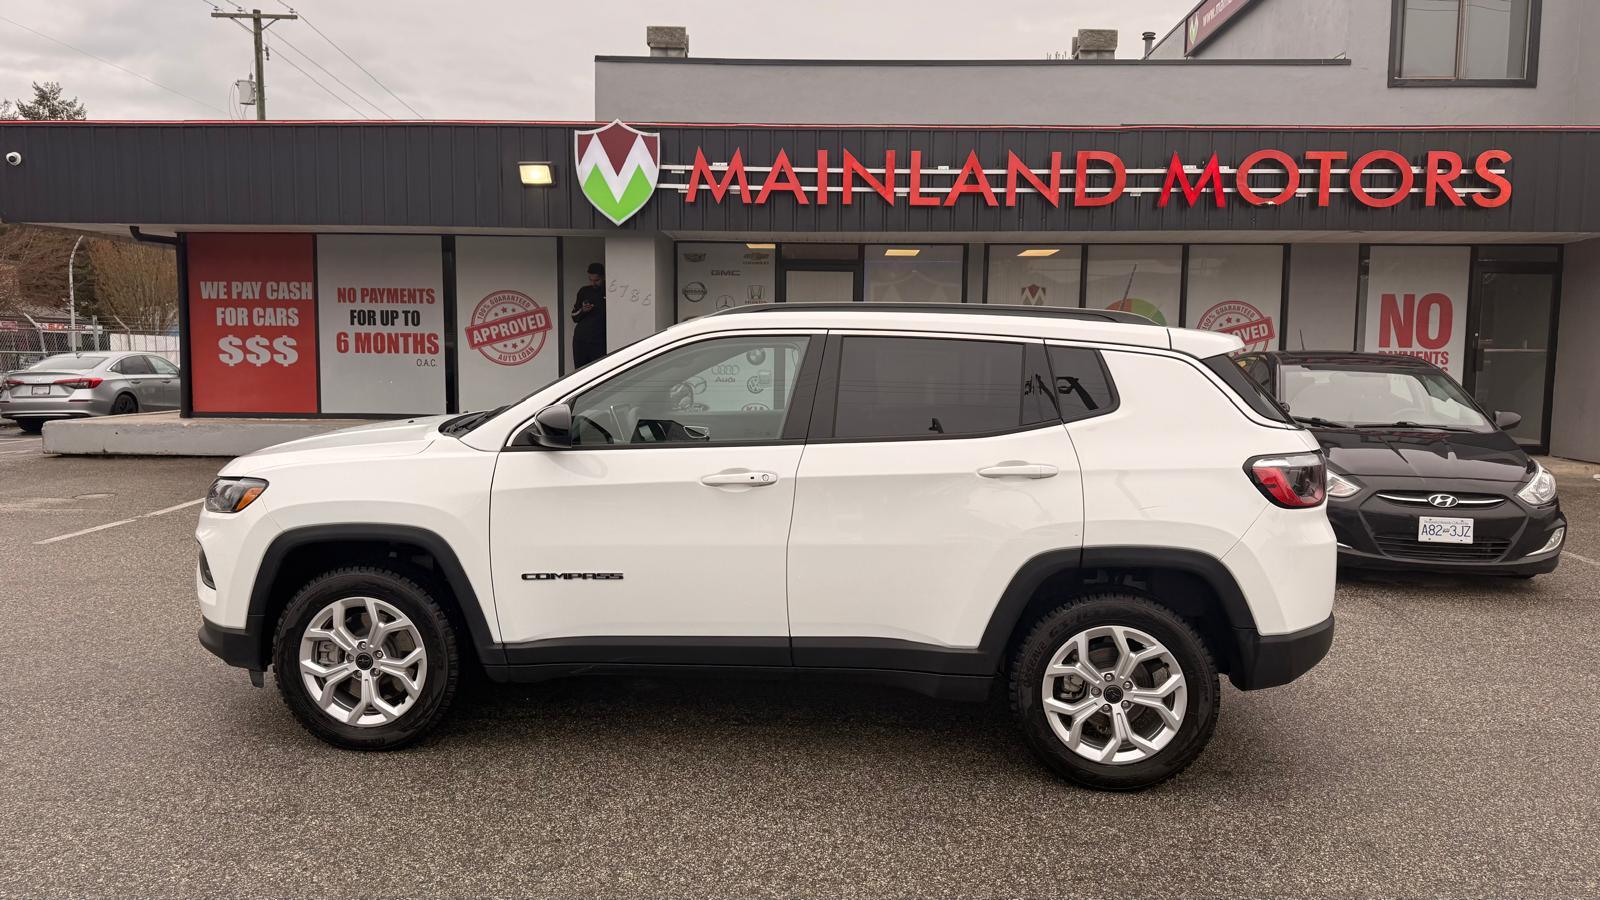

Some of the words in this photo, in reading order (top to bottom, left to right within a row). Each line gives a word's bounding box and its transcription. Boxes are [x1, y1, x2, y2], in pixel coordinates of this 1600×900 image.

[685, 146, 1127, 208] MAINLAND
[1158, 149, 1513, 208] MOTORS
[200, 281, 228, 300] WE
[231, 281, 262, 300] PAY
[266, 281, 313, 300] CASH
[337, 287, 357, 304] NO
[360, 287, 436, 304] PAYMENTS
[216, 307, 249, 327] FOR
[253, 307, 300, 327] CARS
[350, 309, 377, 326] FOR
[380, 310, 399, 326] UP
[402, 310, 421, 327] TO
[1378, 292, 1453, 350] NO
[472, 313, 546, 344] APPROVED
[218, 334, 299, 367] $$$
[336, 331, 350, 354] 6
[354, 331, 440, 355] MONTHS
[498, 353, 517, 362] AUTO
[518, 346, 535, 360] LOAN
[1421, 524, 1443, 537] A82
[1449, 525, 1471, 538] 3JZ
